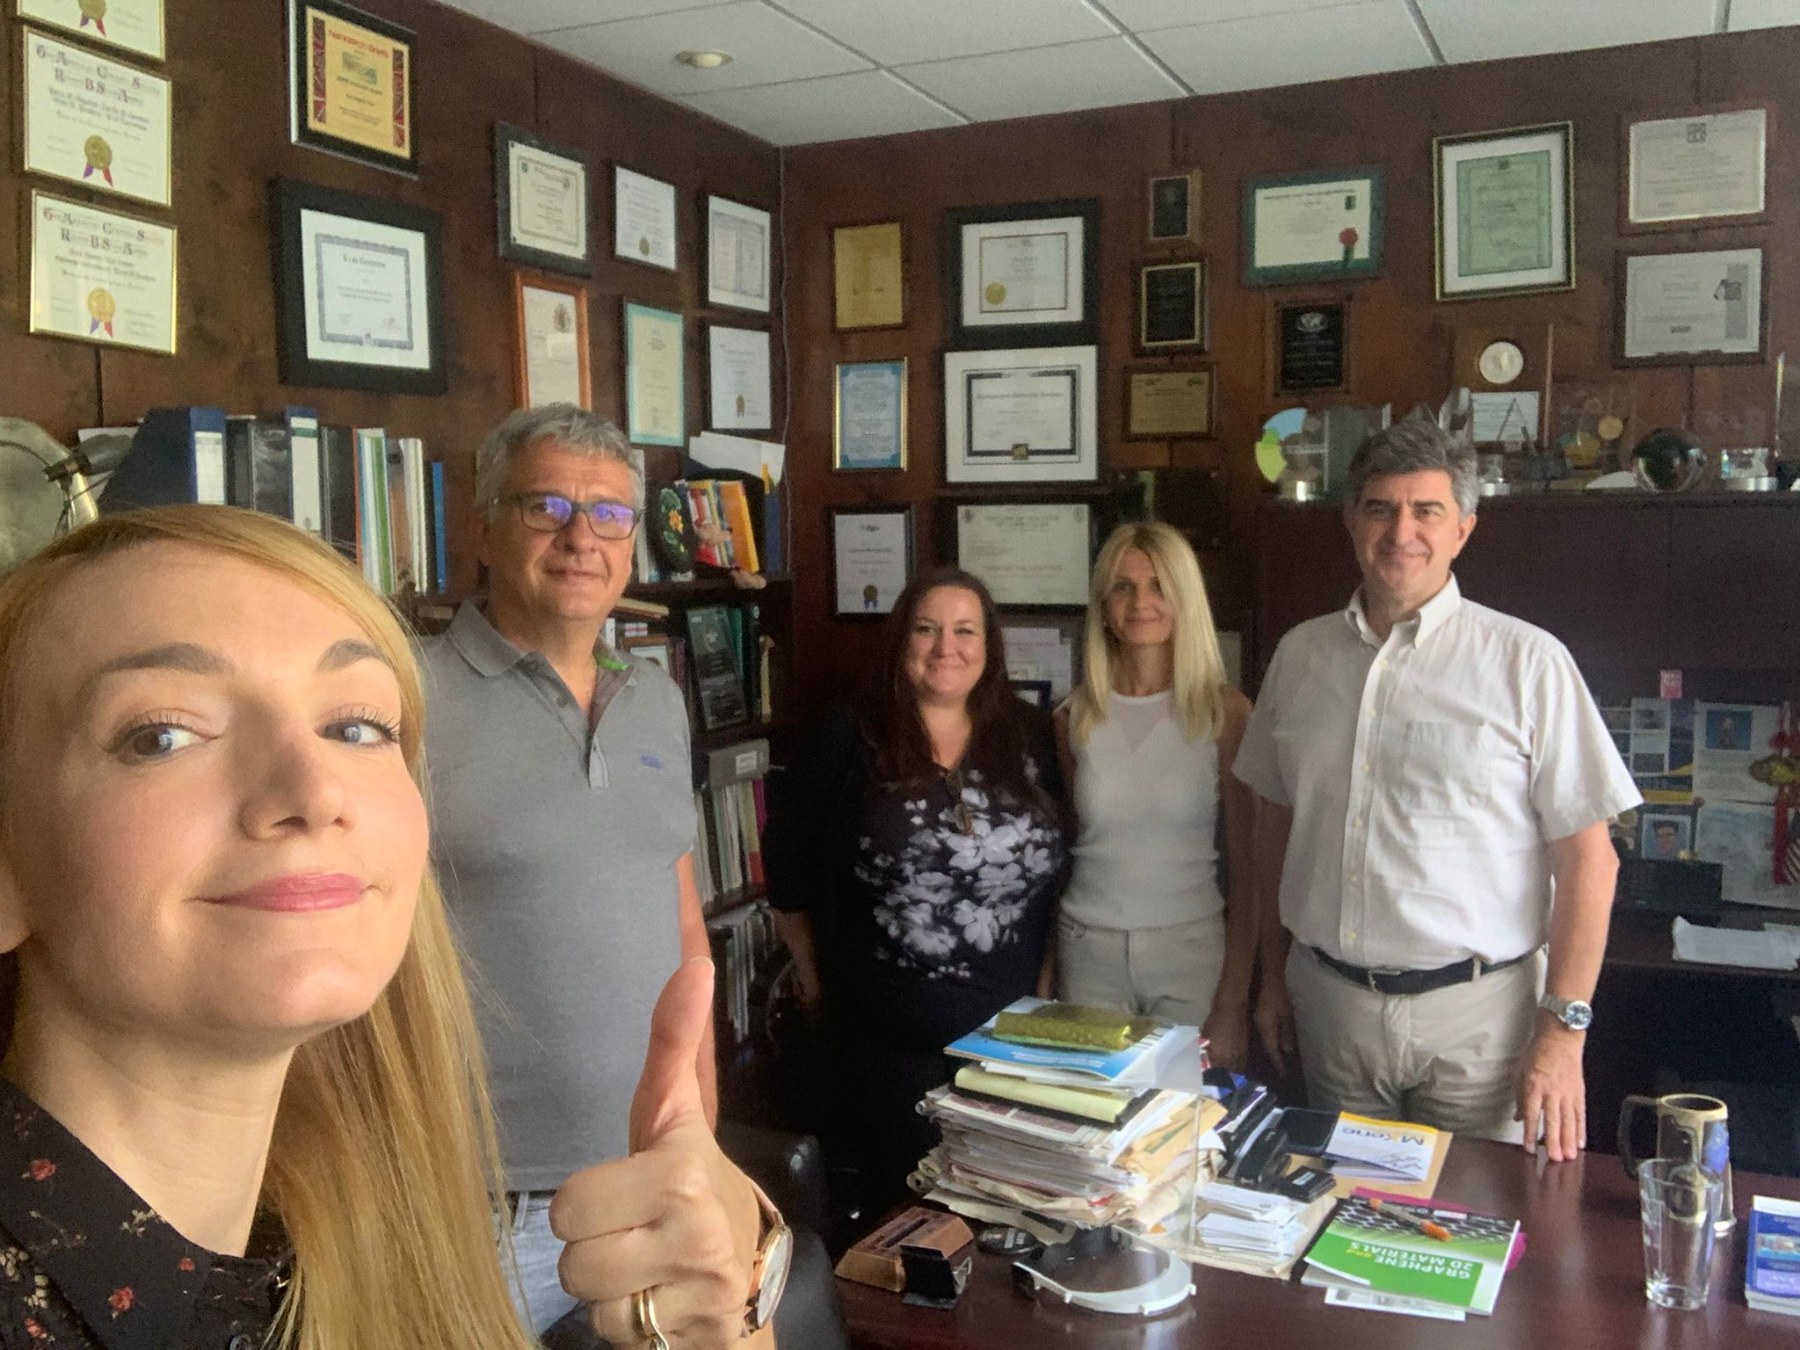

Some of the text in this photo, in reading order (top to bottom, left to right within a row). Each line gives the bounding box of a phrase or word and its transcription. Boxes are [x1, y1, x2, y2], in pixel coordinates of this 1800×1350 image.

[1342, 1128, 1424, 1146] MXene
[1346, 1248, 1471, 1280] GRAPHENE and
[1351, 1242, 1472, 1271] 2D MATERIALS
